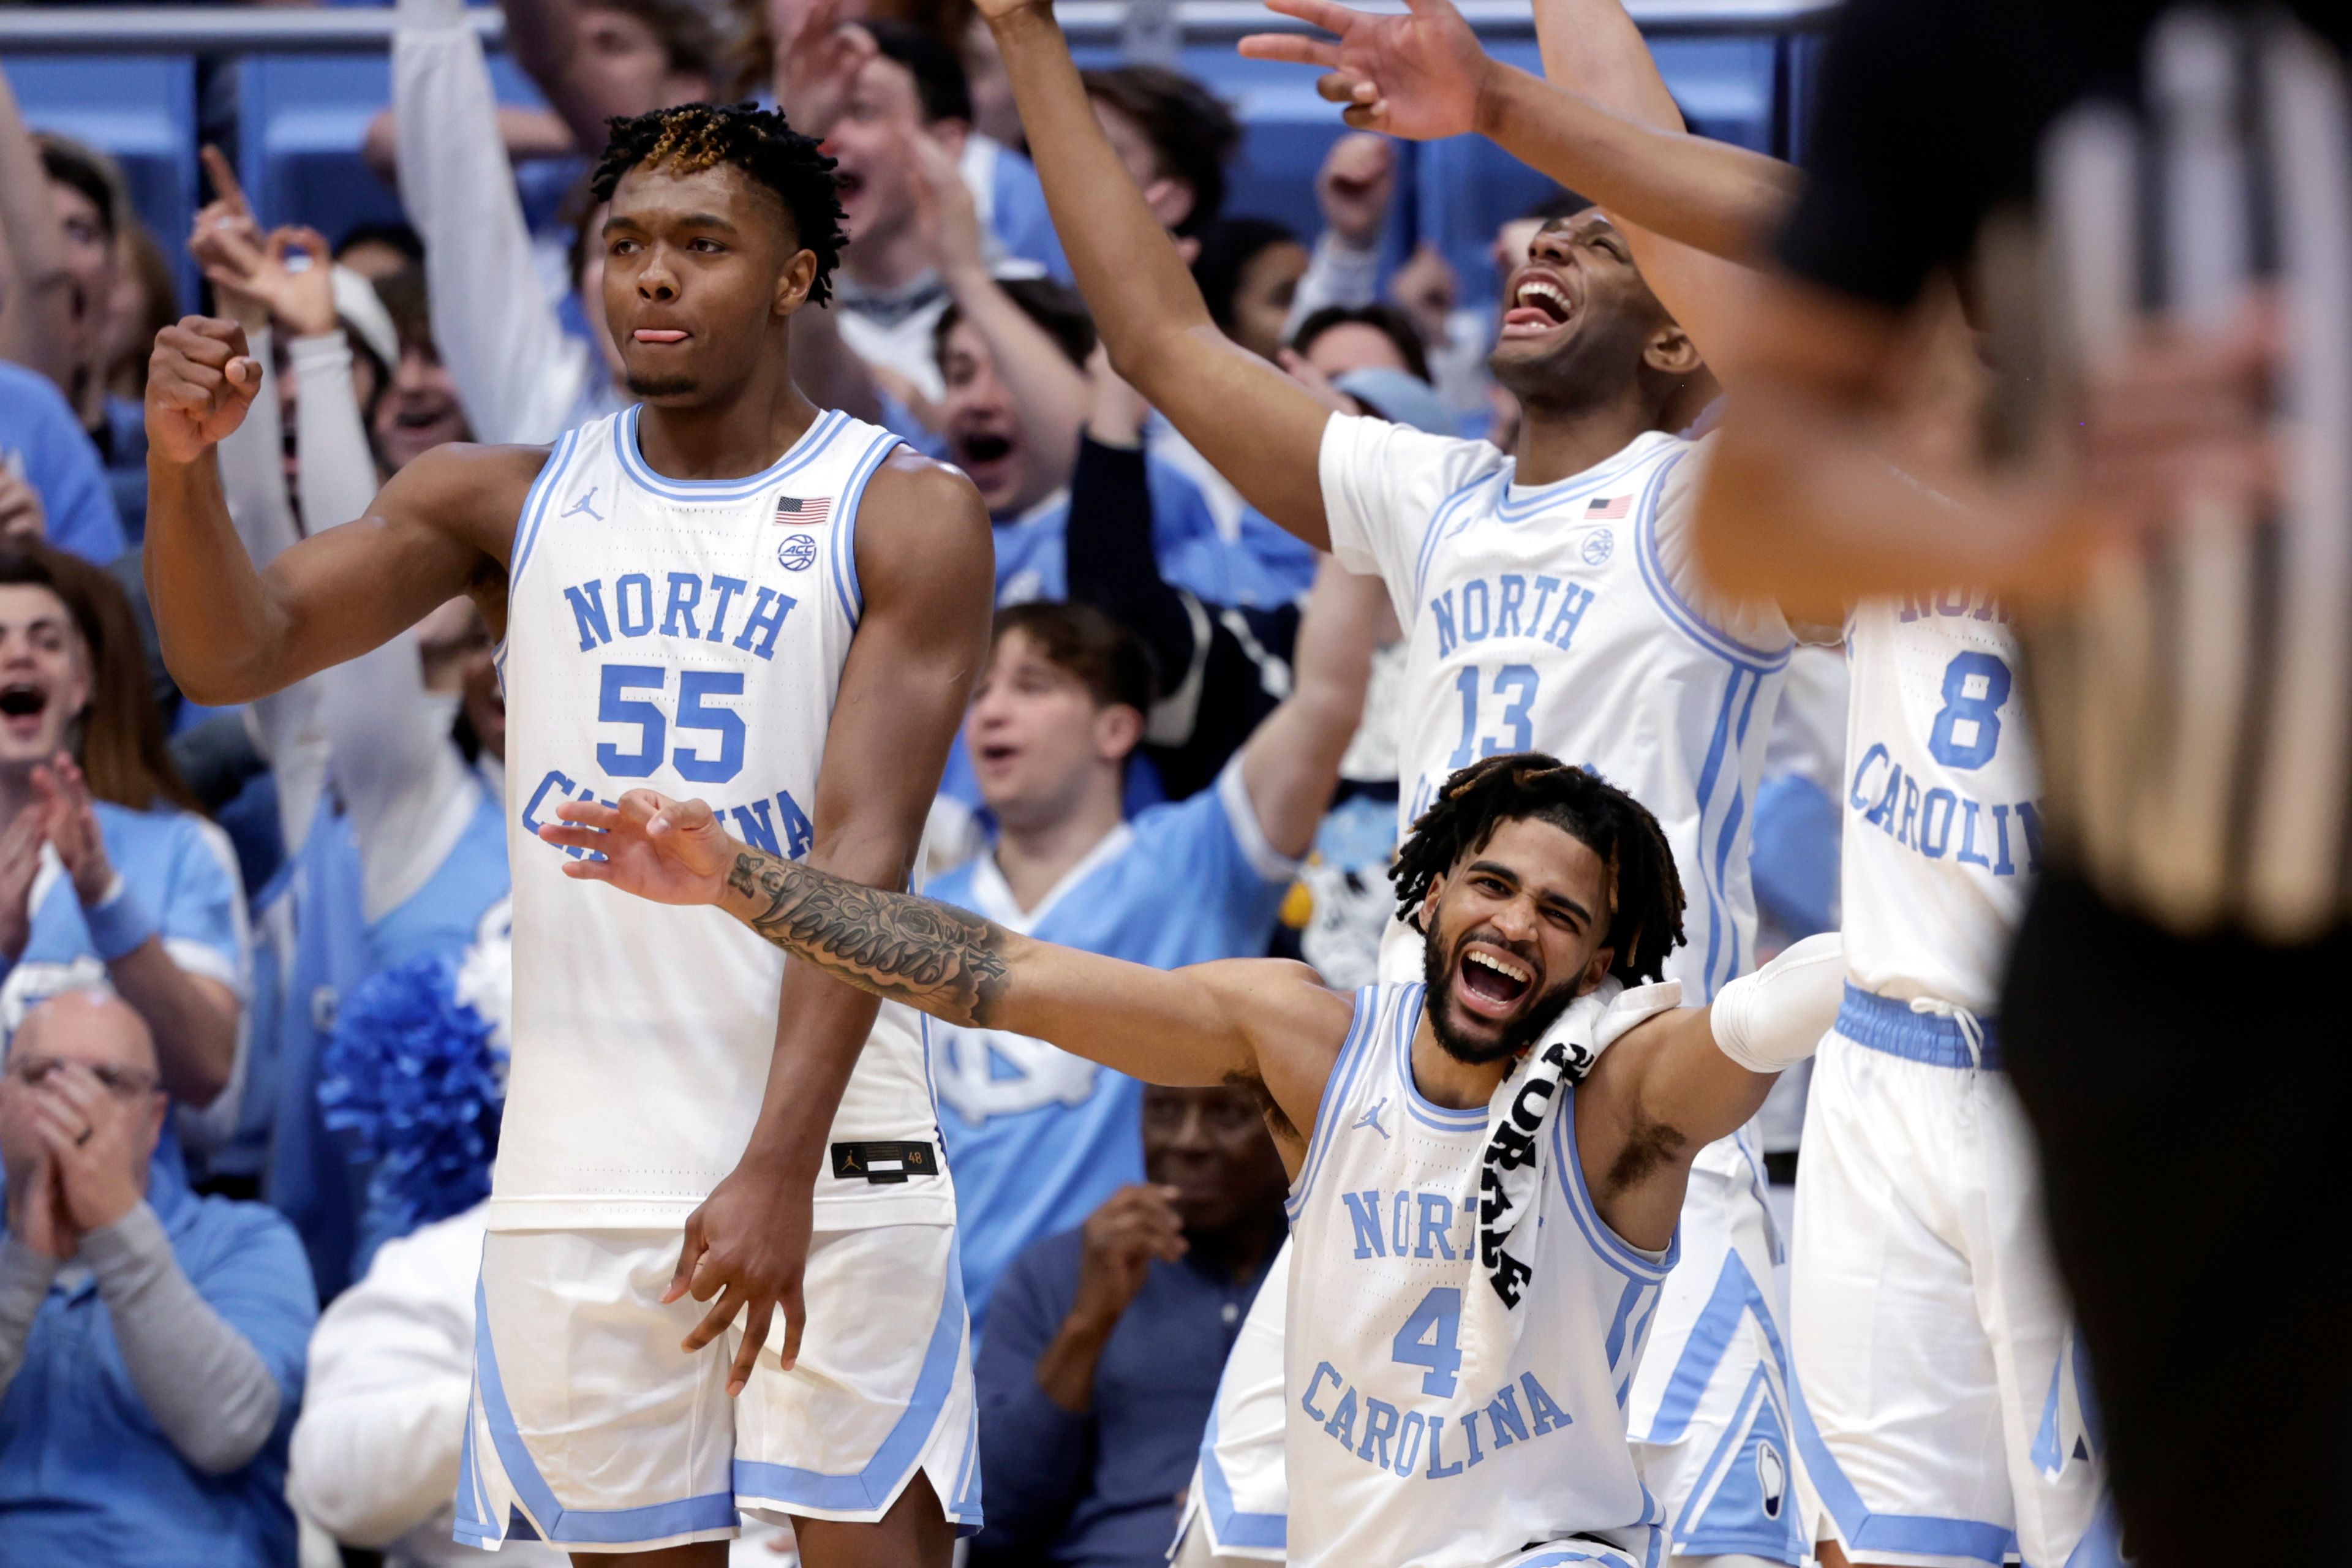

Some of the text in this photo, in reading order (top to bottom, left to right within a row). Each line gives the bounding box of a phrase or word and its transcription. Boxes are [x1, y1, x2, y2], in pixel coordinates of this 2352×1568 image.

[783, 545, 815, 554] ACC
[564, 572, 797, 660] NORTH
[1431, 575, 1595, 660] NORTH
[597, 665, 746, 783] 55
[1447, 664, 1540, 769] 13
[1928, 650, 2011, 770] 8
[1851, 743, 2045, 875] CAROLIN
[908, 1152, 922, 1164] 48
[1342, 1190, 1477, 1260] NOR
[1392, 1287, 1462, 1398] 4
[1302, 1361, 1572, 1479] CAROLINA
